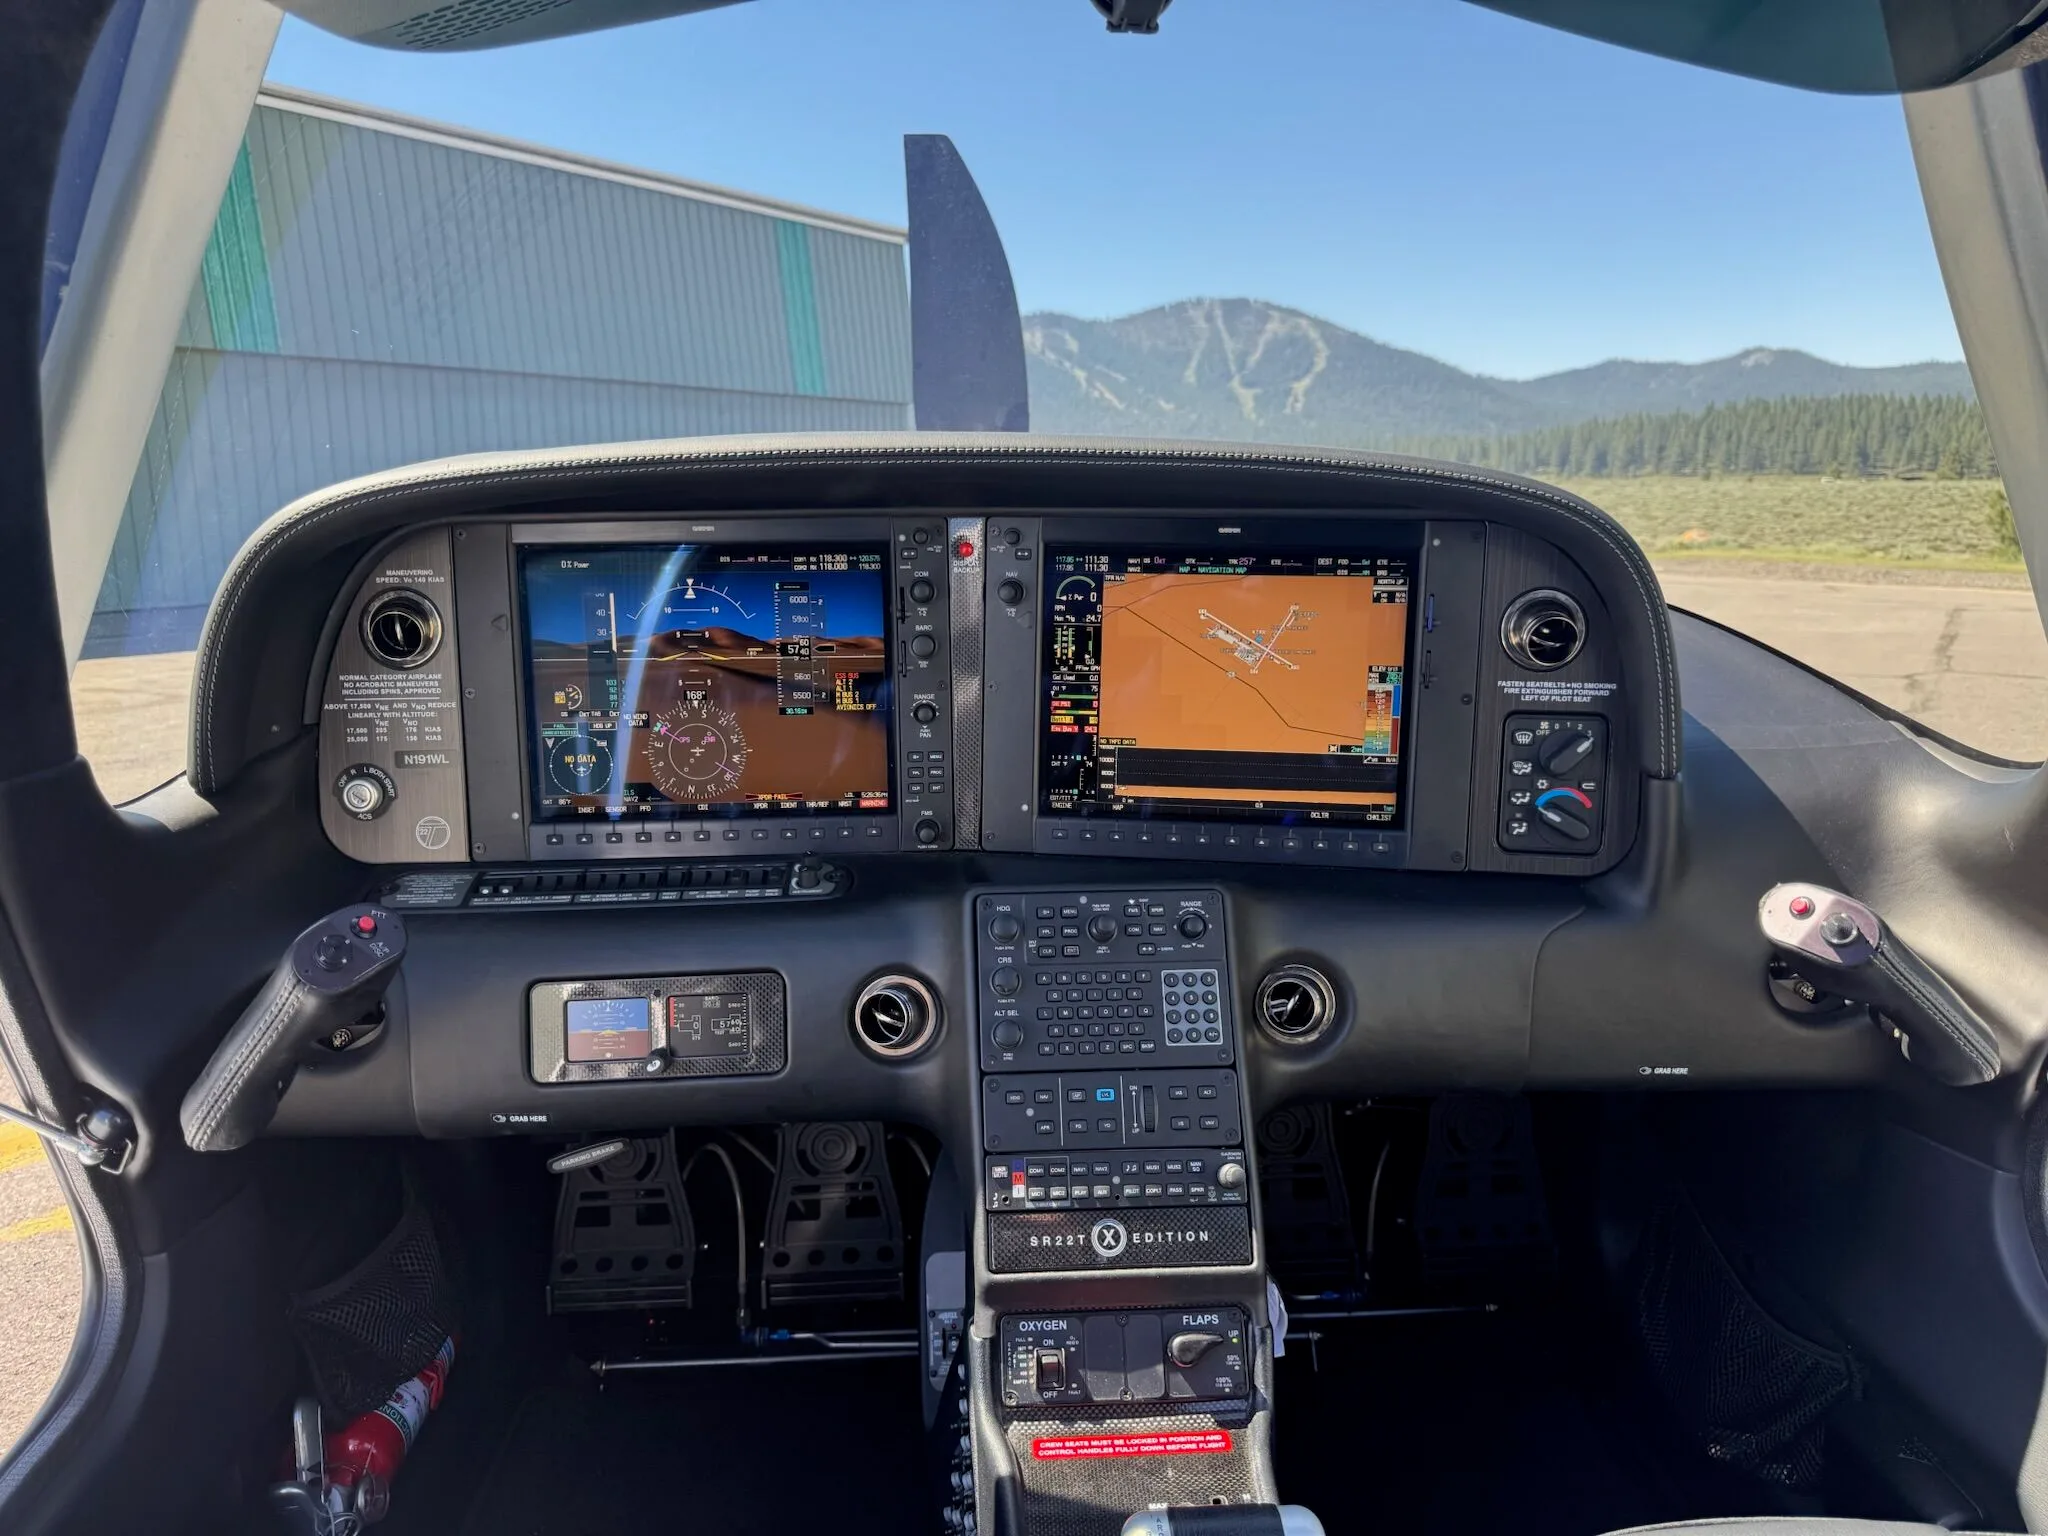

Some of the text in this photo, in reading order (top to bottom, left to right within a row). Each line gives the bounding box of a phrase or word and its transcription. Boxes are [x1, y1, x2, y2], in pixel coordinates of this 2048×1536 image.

[819, 554, 847, 562] 118.300
[1085, 564, 1108, 572] 111.30
[1521, 687, 1572, 695] EXTINGUISHER
[404, 754, 450, 765] N191WL
[578, 755, 596, 763] DATA
[368, 768, 386, 779] BOTH
[338, 775, 348, 788] OFF
[383, 778, 396, 797] START
[371, 910, 387, 919] PTT
[1671, 1067, 1688, 1075] HERE
[561, 1145, 615, 1167] PARKING BRAKE
[1030, 1228, 1209, 1246] SR22T X EDITION
[1182, 1314, 1219, 1325] FLAPS
[1019, 1320, 1067, 1331] OXYGEN
[1043, 1391, 1058, 1399] OFF
[1038, 1448, 1076, 1456] CONTROL
